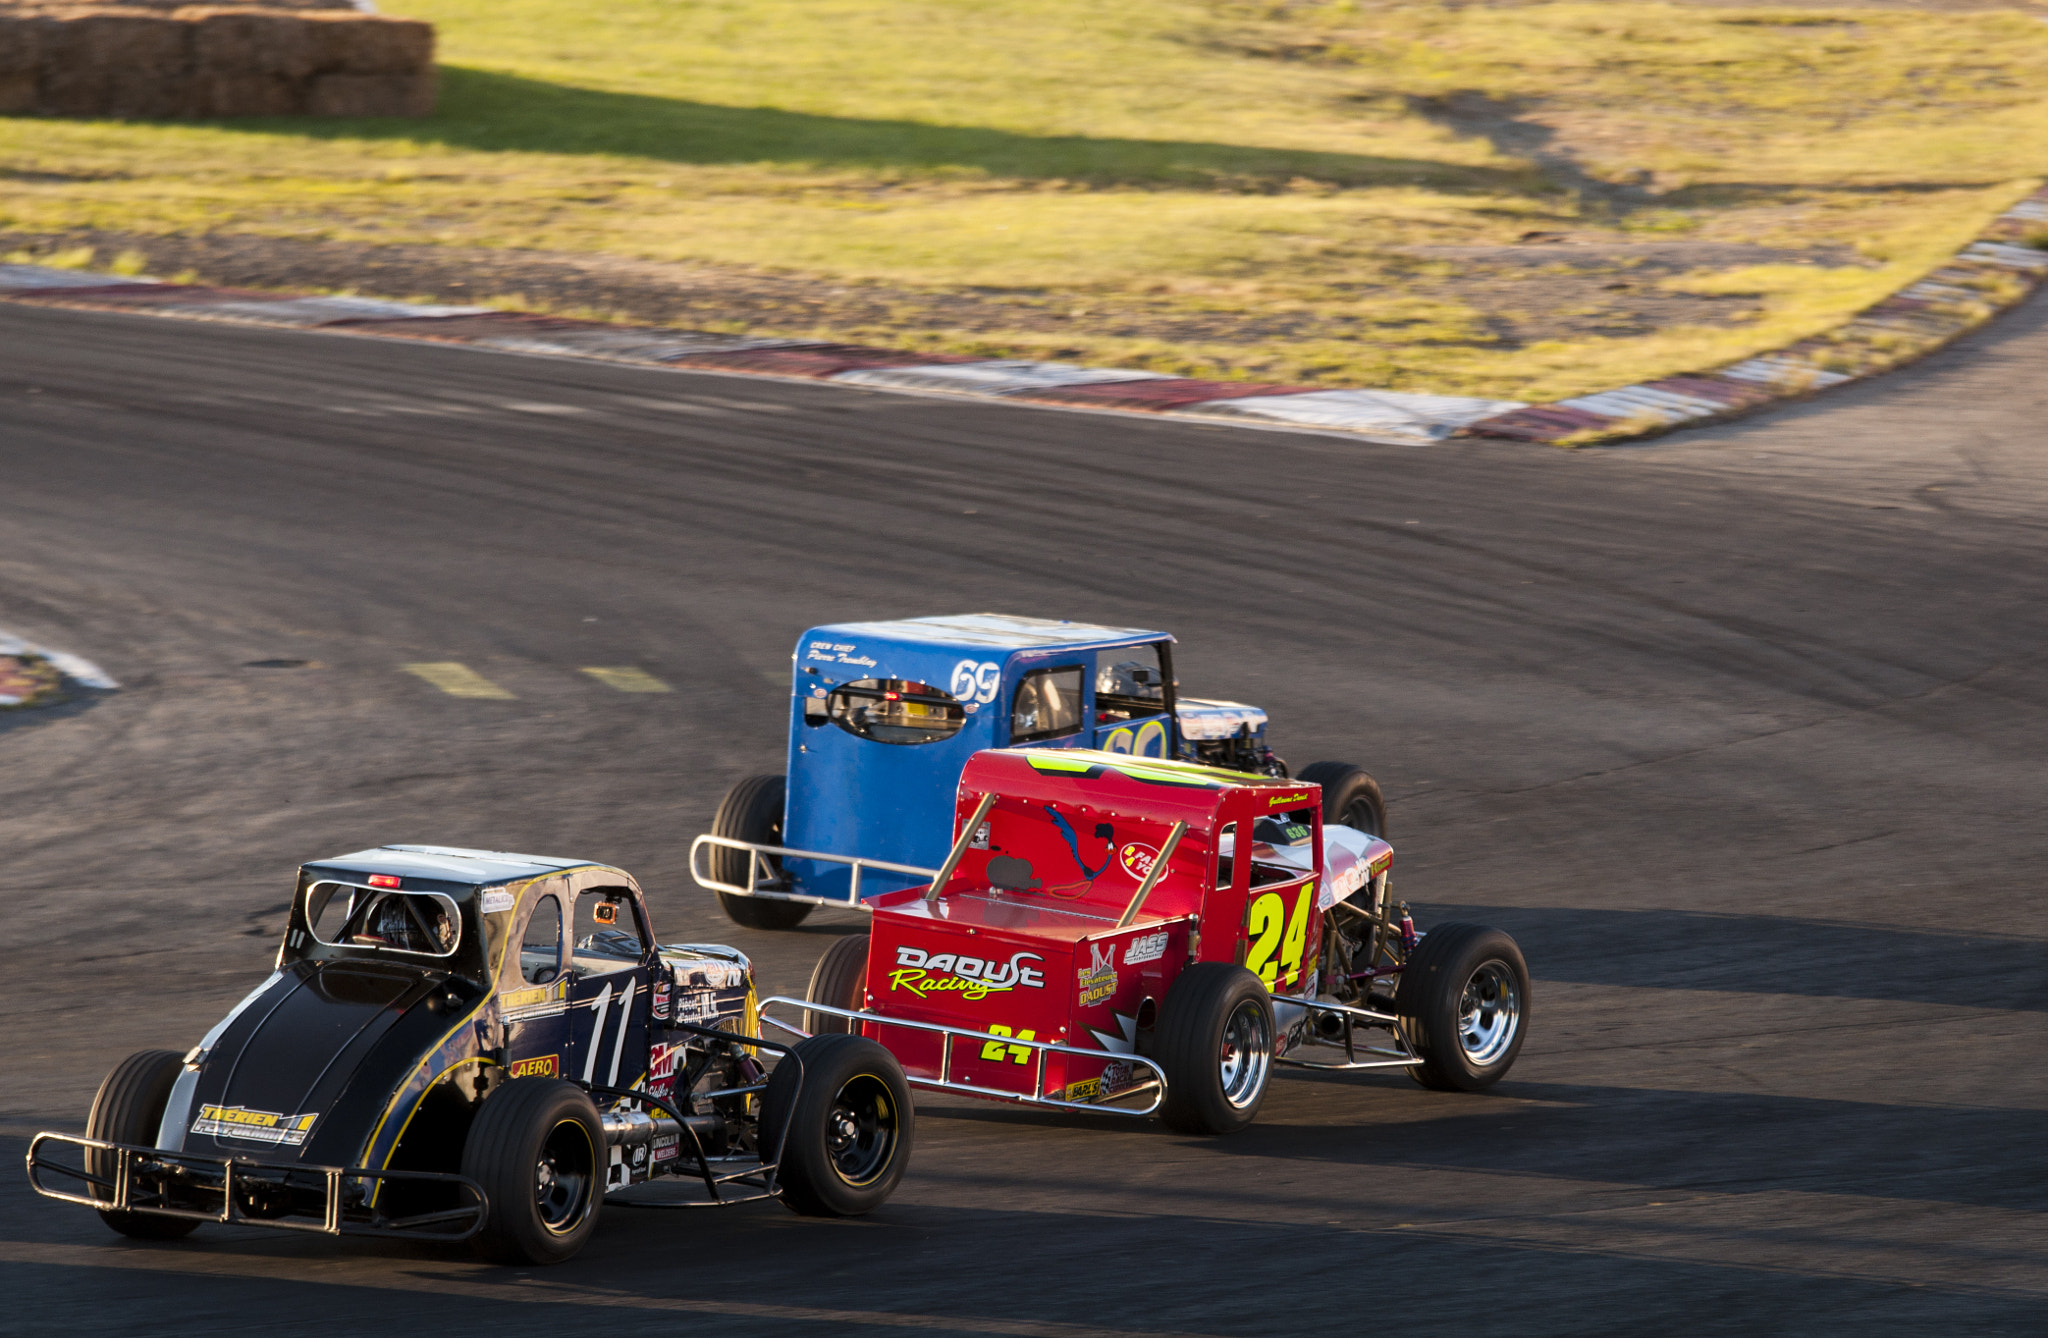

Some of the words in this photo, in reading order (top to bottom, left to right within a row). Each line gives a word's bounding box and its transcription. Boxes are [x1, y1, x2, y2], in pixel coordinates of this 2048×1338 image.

[951, 659, 1000, 704] 69
[1124, 845, 1136, 857] 2
[1124, 856, 1135, 867] 4
[1135, 861, 1153, 875] YO
[1125, 931, 1170, 958] JASS
[1246, 881, 1314, 994] 24
[888, 968, 1013, 1000] Racing
[1080, 982, 1118, 1005] DAOUST
[583, 976, 636, 1088] 11
[978, 1024, 1036, 1065] 24
[517, 1059, 552, 1078] AERO
[195, 1119, 307, 1142] PERFORMANCE
